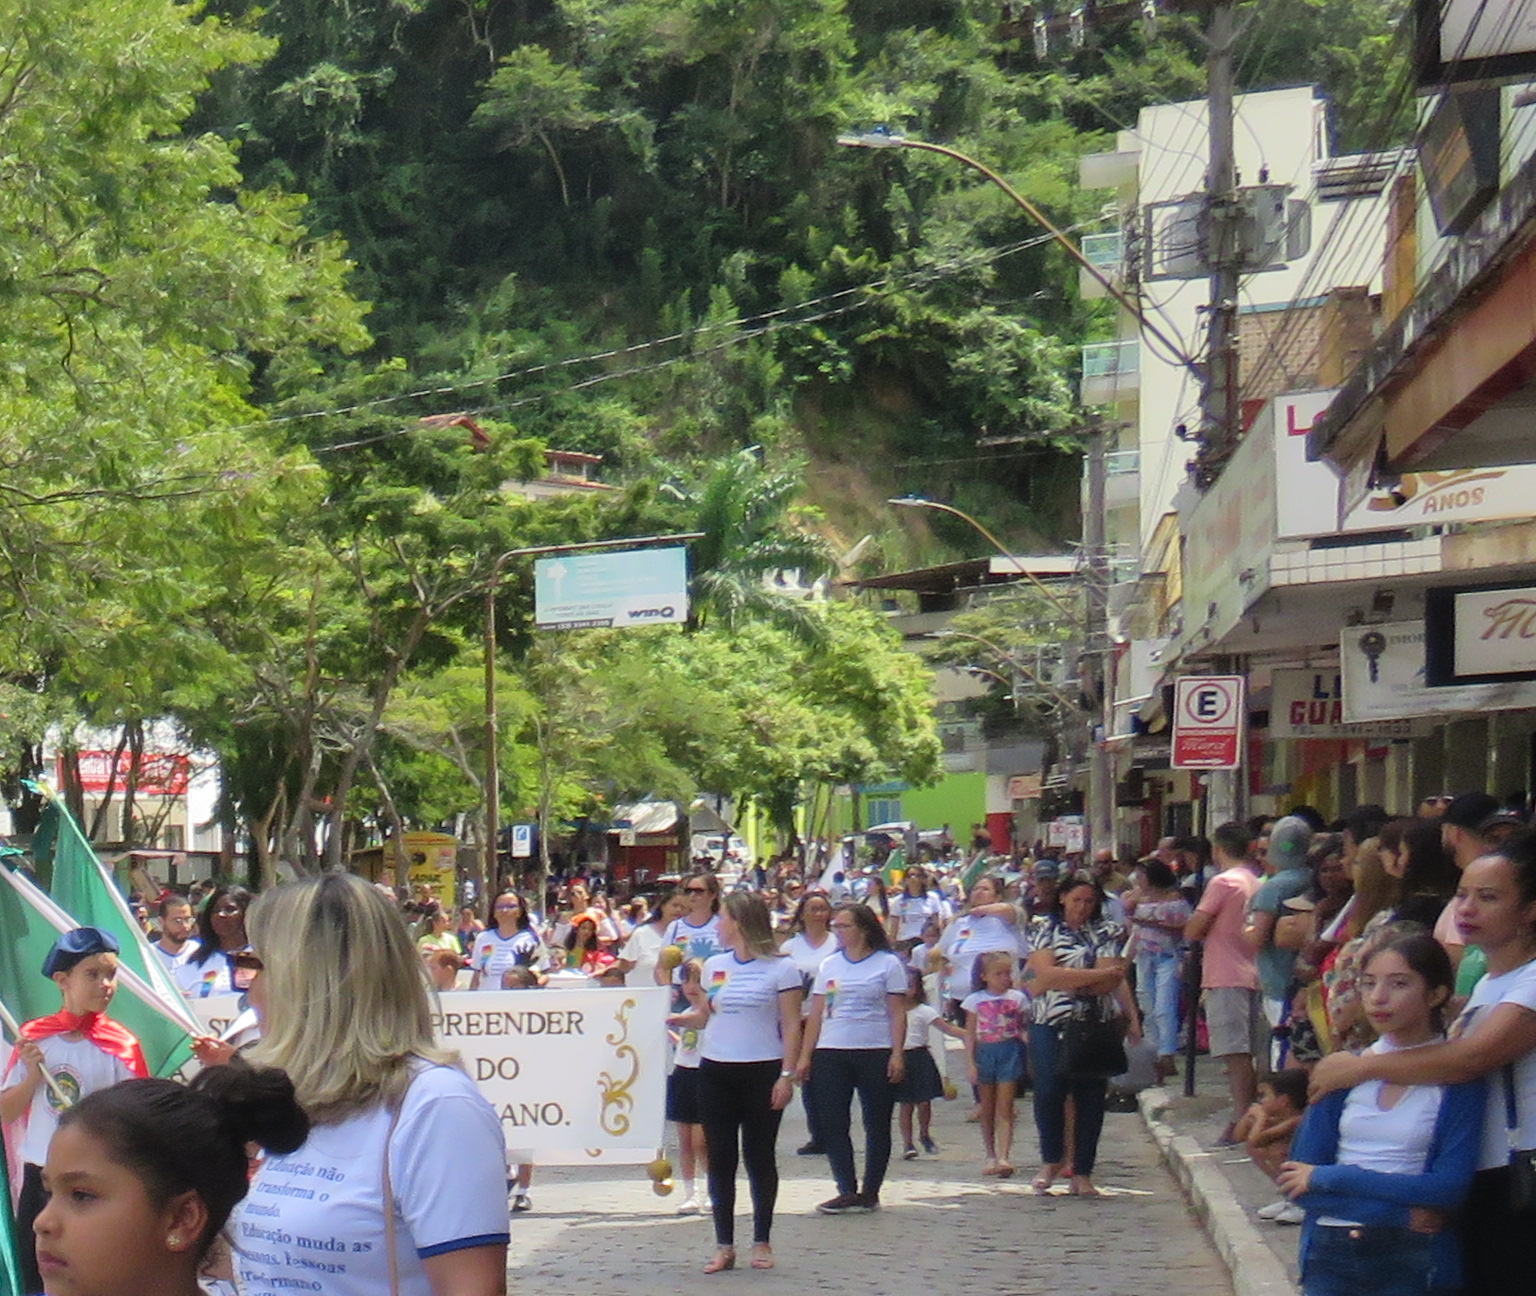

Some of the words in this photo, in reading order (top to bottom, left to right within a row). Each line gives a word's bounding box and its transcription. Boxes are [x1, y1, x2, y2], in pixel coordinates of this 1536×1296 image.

[1421, 487, 1486, 516] ANOS
[1197, 691, 1218, 716] E
[476, 1057, 520, 1082] DO
[317, 1167, 347, 1183] não
[296, 1236, 347, 1253] muda
[352, 1241, 374, 1253] as
